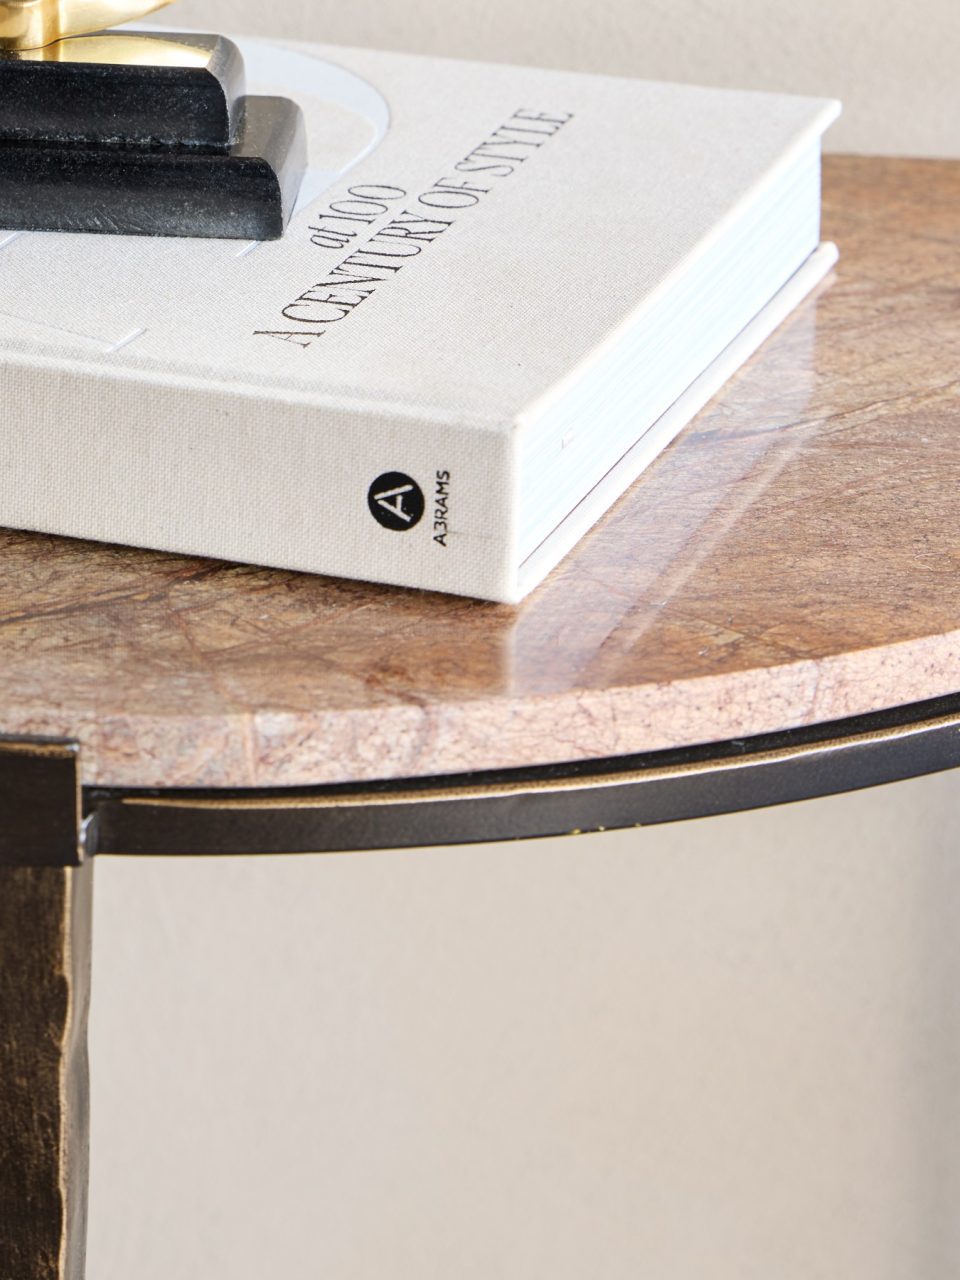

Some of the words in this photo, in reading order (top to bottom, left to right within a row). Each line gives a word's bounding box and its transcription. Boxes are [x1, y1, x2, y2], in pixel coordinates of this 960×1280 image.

[454, 108, 574, 177] STYLE
[319, 184, 407, 225] 100
[418, 177, 490, 209] OF
[308, 225, 358, 249] at
[281, 210, 456, 323] CENTURY
[253, 329, 326, 349] A
